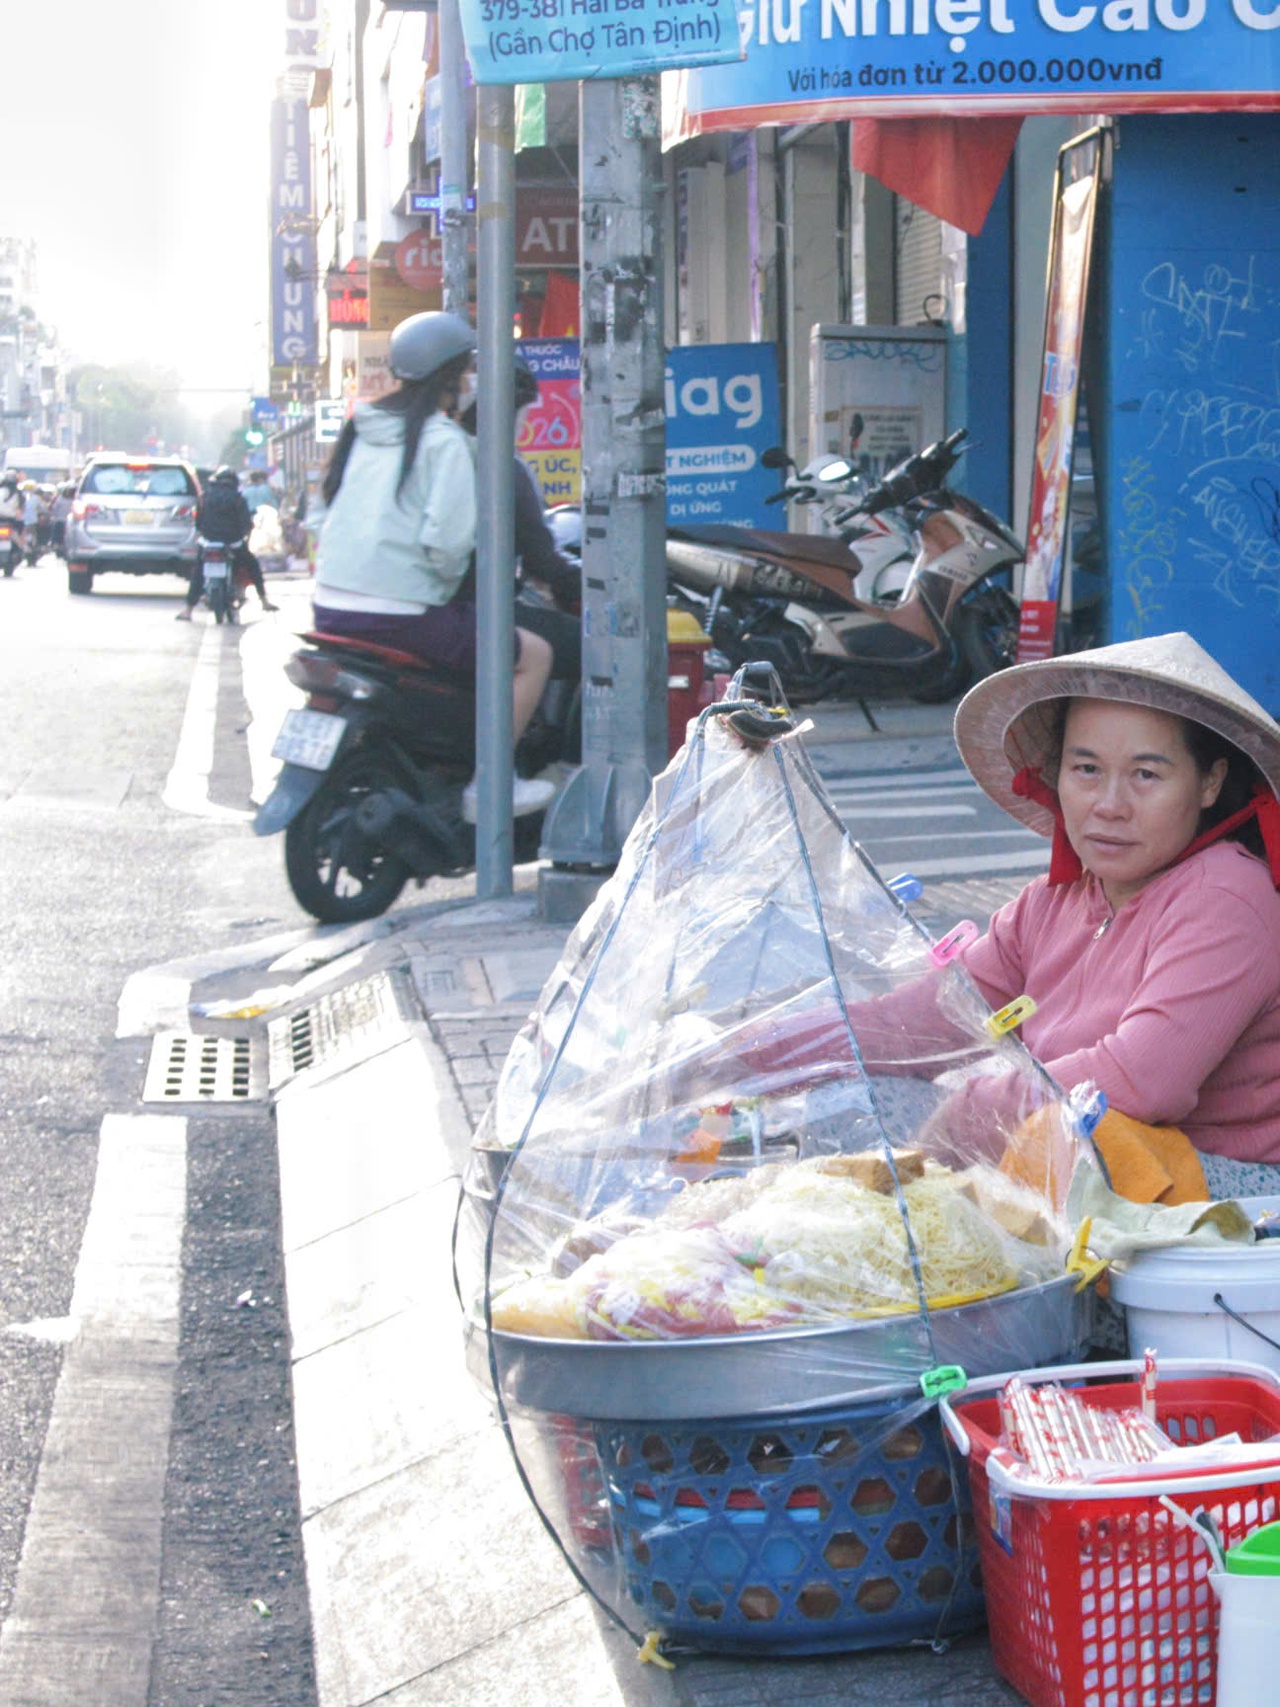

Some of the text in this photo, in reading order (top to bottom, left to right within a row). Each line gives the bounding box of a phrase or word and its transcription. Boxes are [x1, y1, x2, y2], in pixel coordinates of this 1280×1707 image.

[489, 12, 720, 62] (Gần Chợ Tân Định)
[788, 57, 1162, 92] Với hóa đơn từ 2.000.000vnđ
